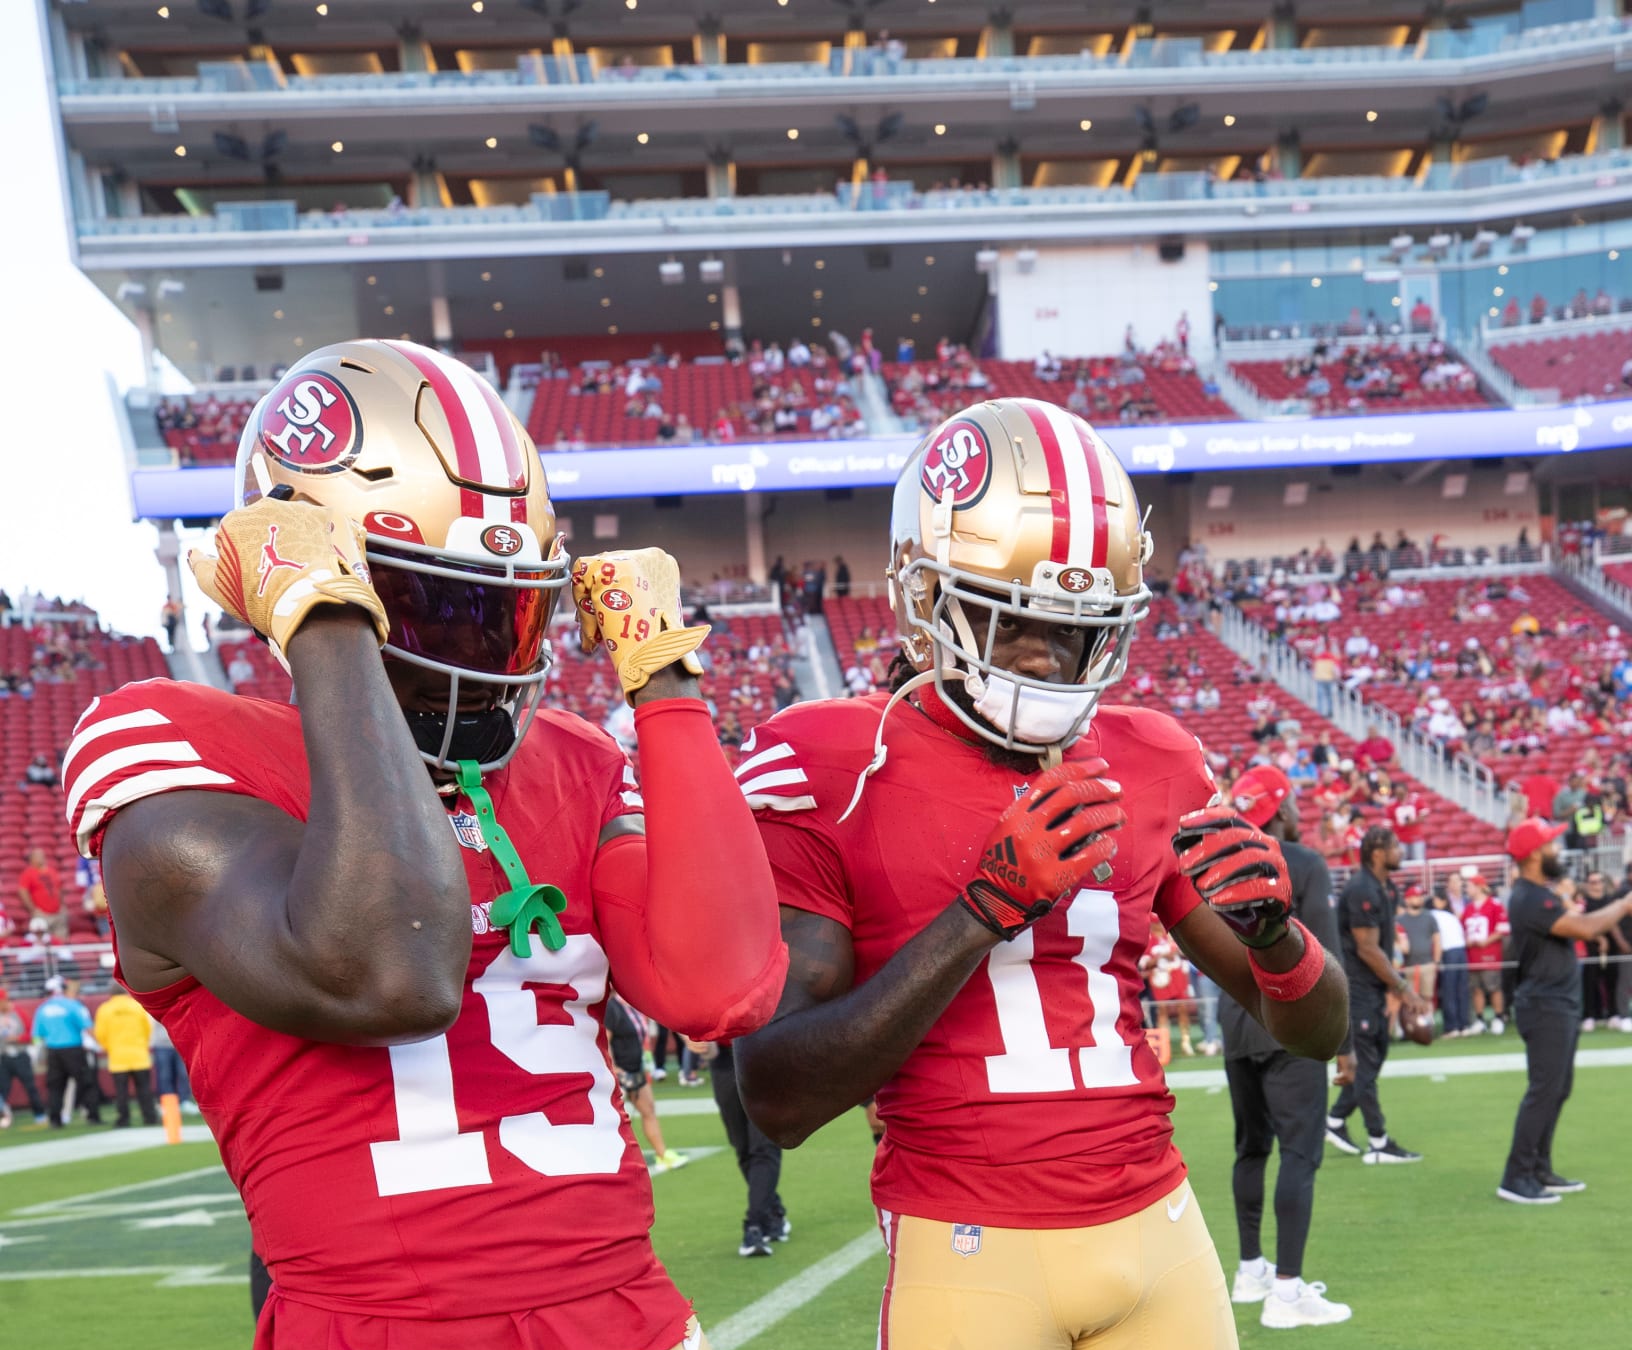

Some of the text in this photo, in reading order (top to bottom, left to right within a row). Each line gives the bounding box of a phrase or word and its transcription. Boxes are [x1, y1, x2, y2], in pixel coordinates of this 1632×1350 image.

[494, 529, 517, 552] SF
[1068, 571, 1089, 589] SF
[620, 614, 650, 642] 19
[981, 858, 1027, 888] adidas
[985, 888, 1141, 1093] 11
[370, 933, 626, 1197] 19
[956, 1236, 977, 1250] NFL
